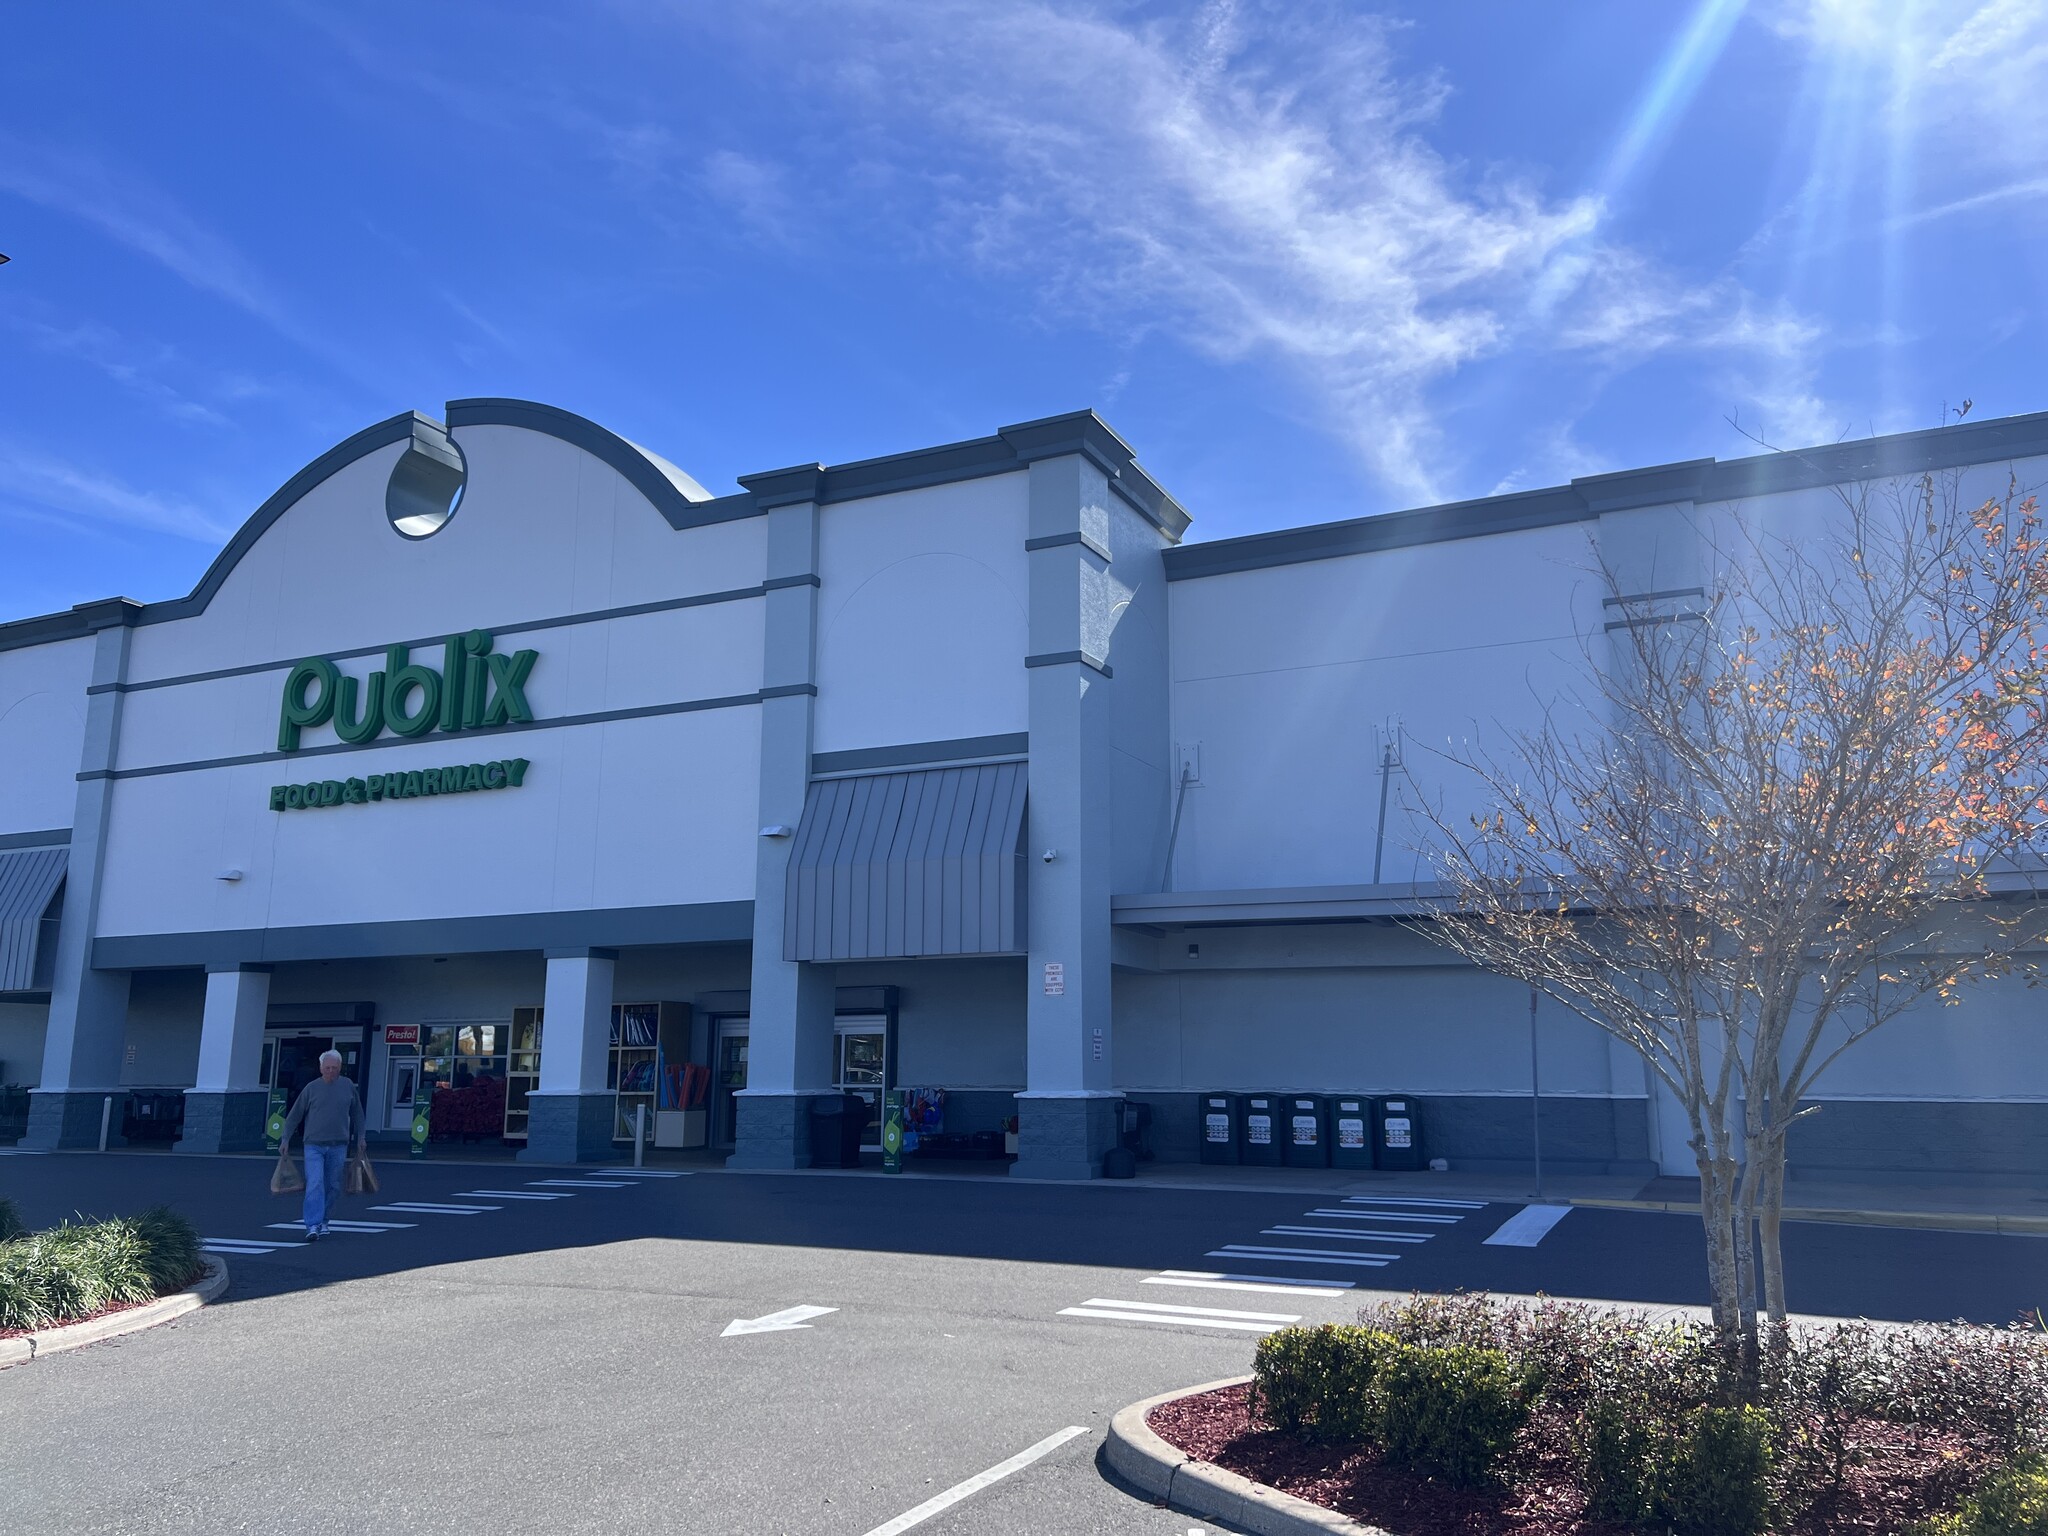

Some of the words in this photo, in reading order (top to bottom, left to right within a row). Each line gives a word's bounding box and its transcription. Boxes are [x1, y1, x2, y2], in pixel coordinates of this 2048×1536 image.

[277, 629, 539, 752] Publix
[270, 780, 345, 811] FOOD
[342, 777, 368, 804] &
[366, 758, 531, 801] PHARMACY
[387, 1029, 417, 1039] Presto!
